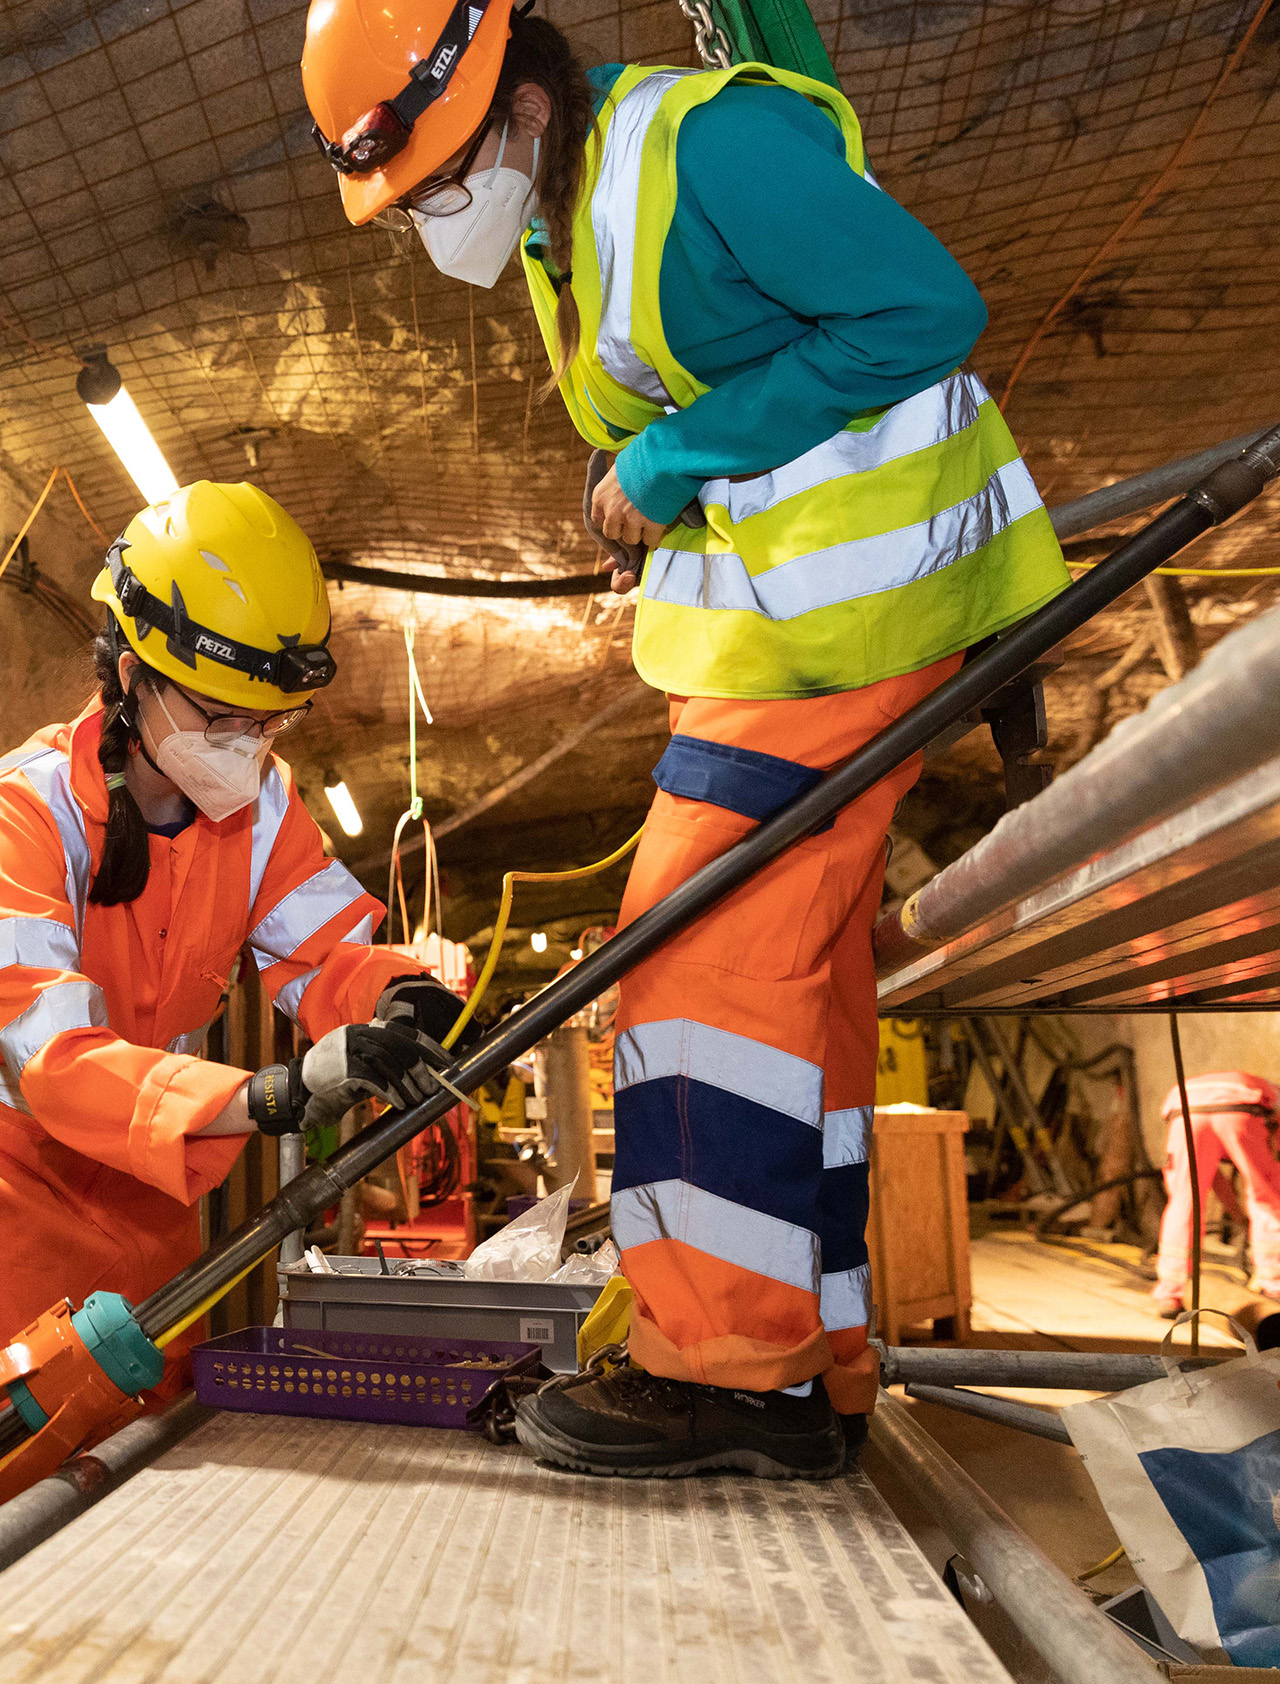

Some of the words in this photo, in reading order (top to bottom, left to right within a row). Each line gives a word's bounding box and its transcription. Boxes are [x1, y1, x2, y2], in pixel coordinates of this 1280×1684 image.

[430, 44, 458, 80] ETZL
[195, 635, 236, 661] PETZL
[264, 1074, 278, 1116] RESISTA
